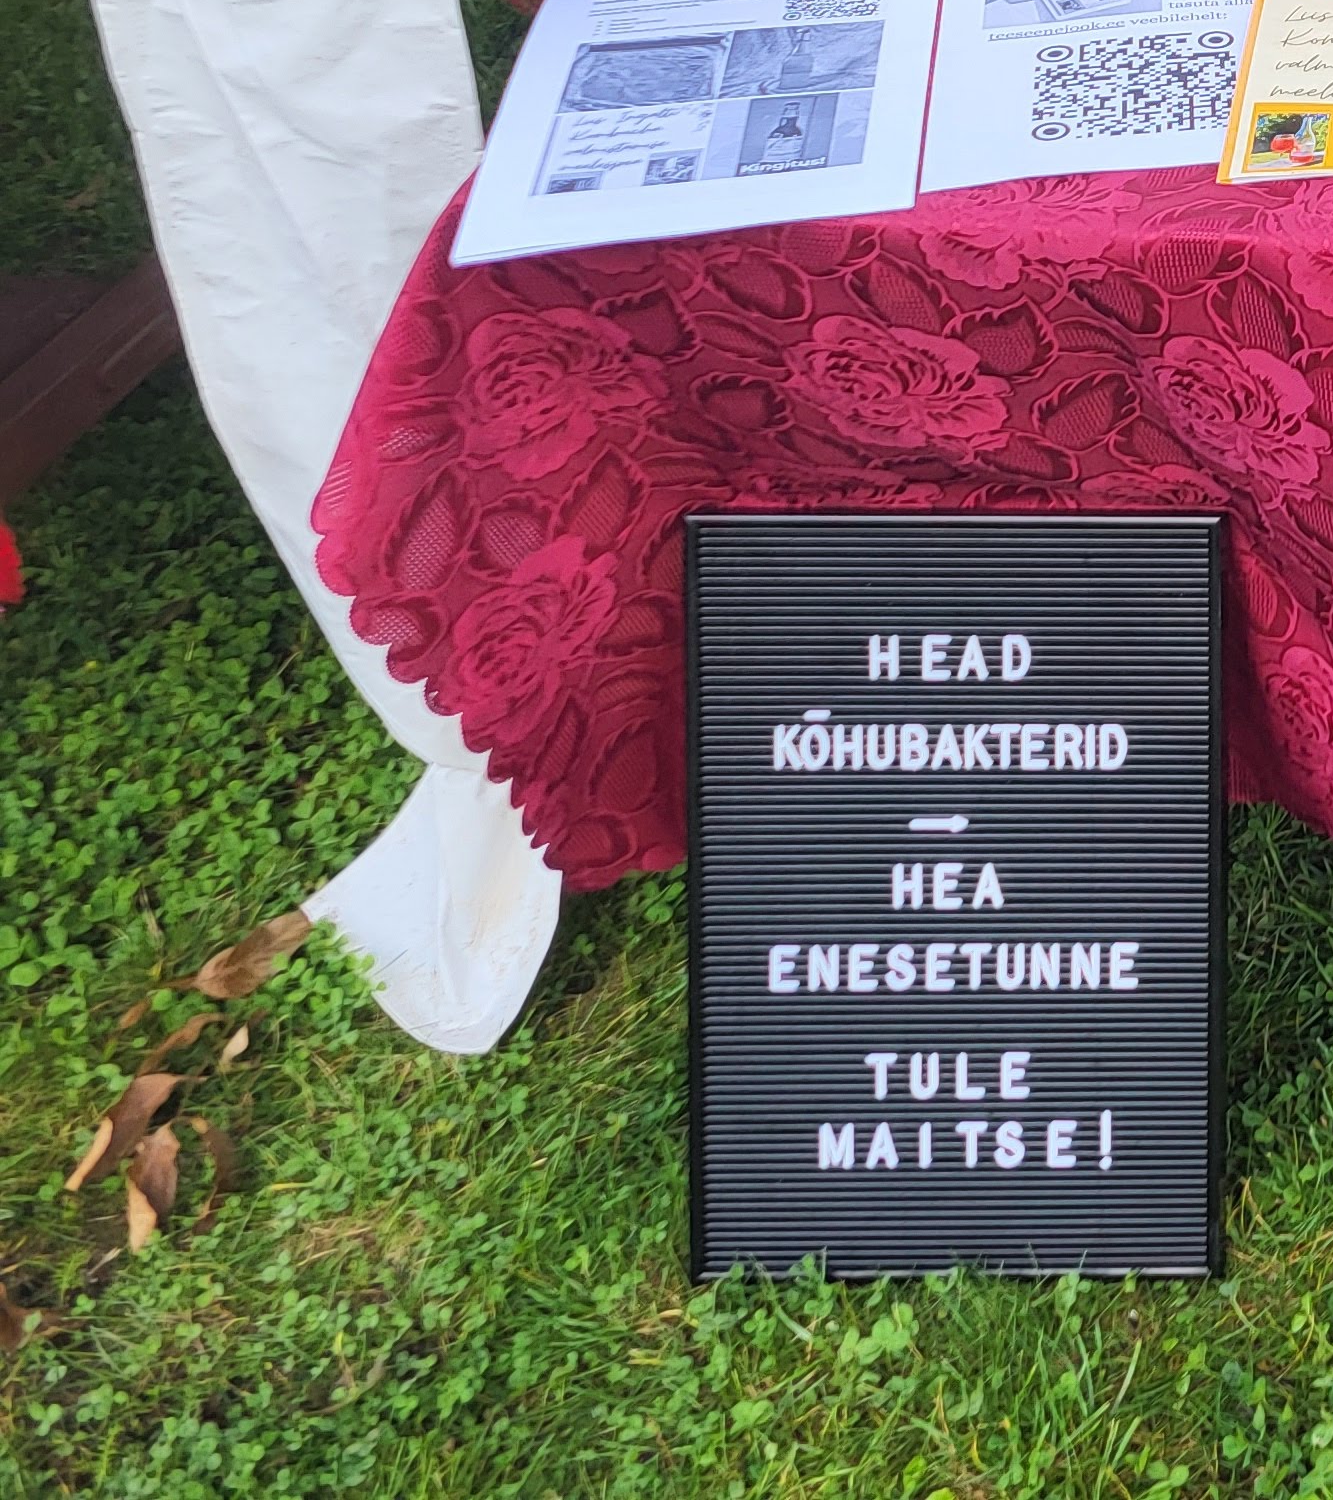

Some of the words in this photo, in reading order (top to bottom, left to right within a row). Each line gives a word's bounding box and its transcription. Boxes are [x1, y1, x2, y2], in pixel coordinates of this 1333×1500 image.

[1129, 11, 1227, 24] veebilehelt:
[1169, 0, 1218, 8] tasuta
[868, 634, 1034, 681] HEAD
[891, 862, 1005, 910] HEA
[768, 942, 1140, 992] ENESETUNNE
[864, 1052, 1032, 1100] TULE
[817, 1109, 1114, 1170] MAITSE!
